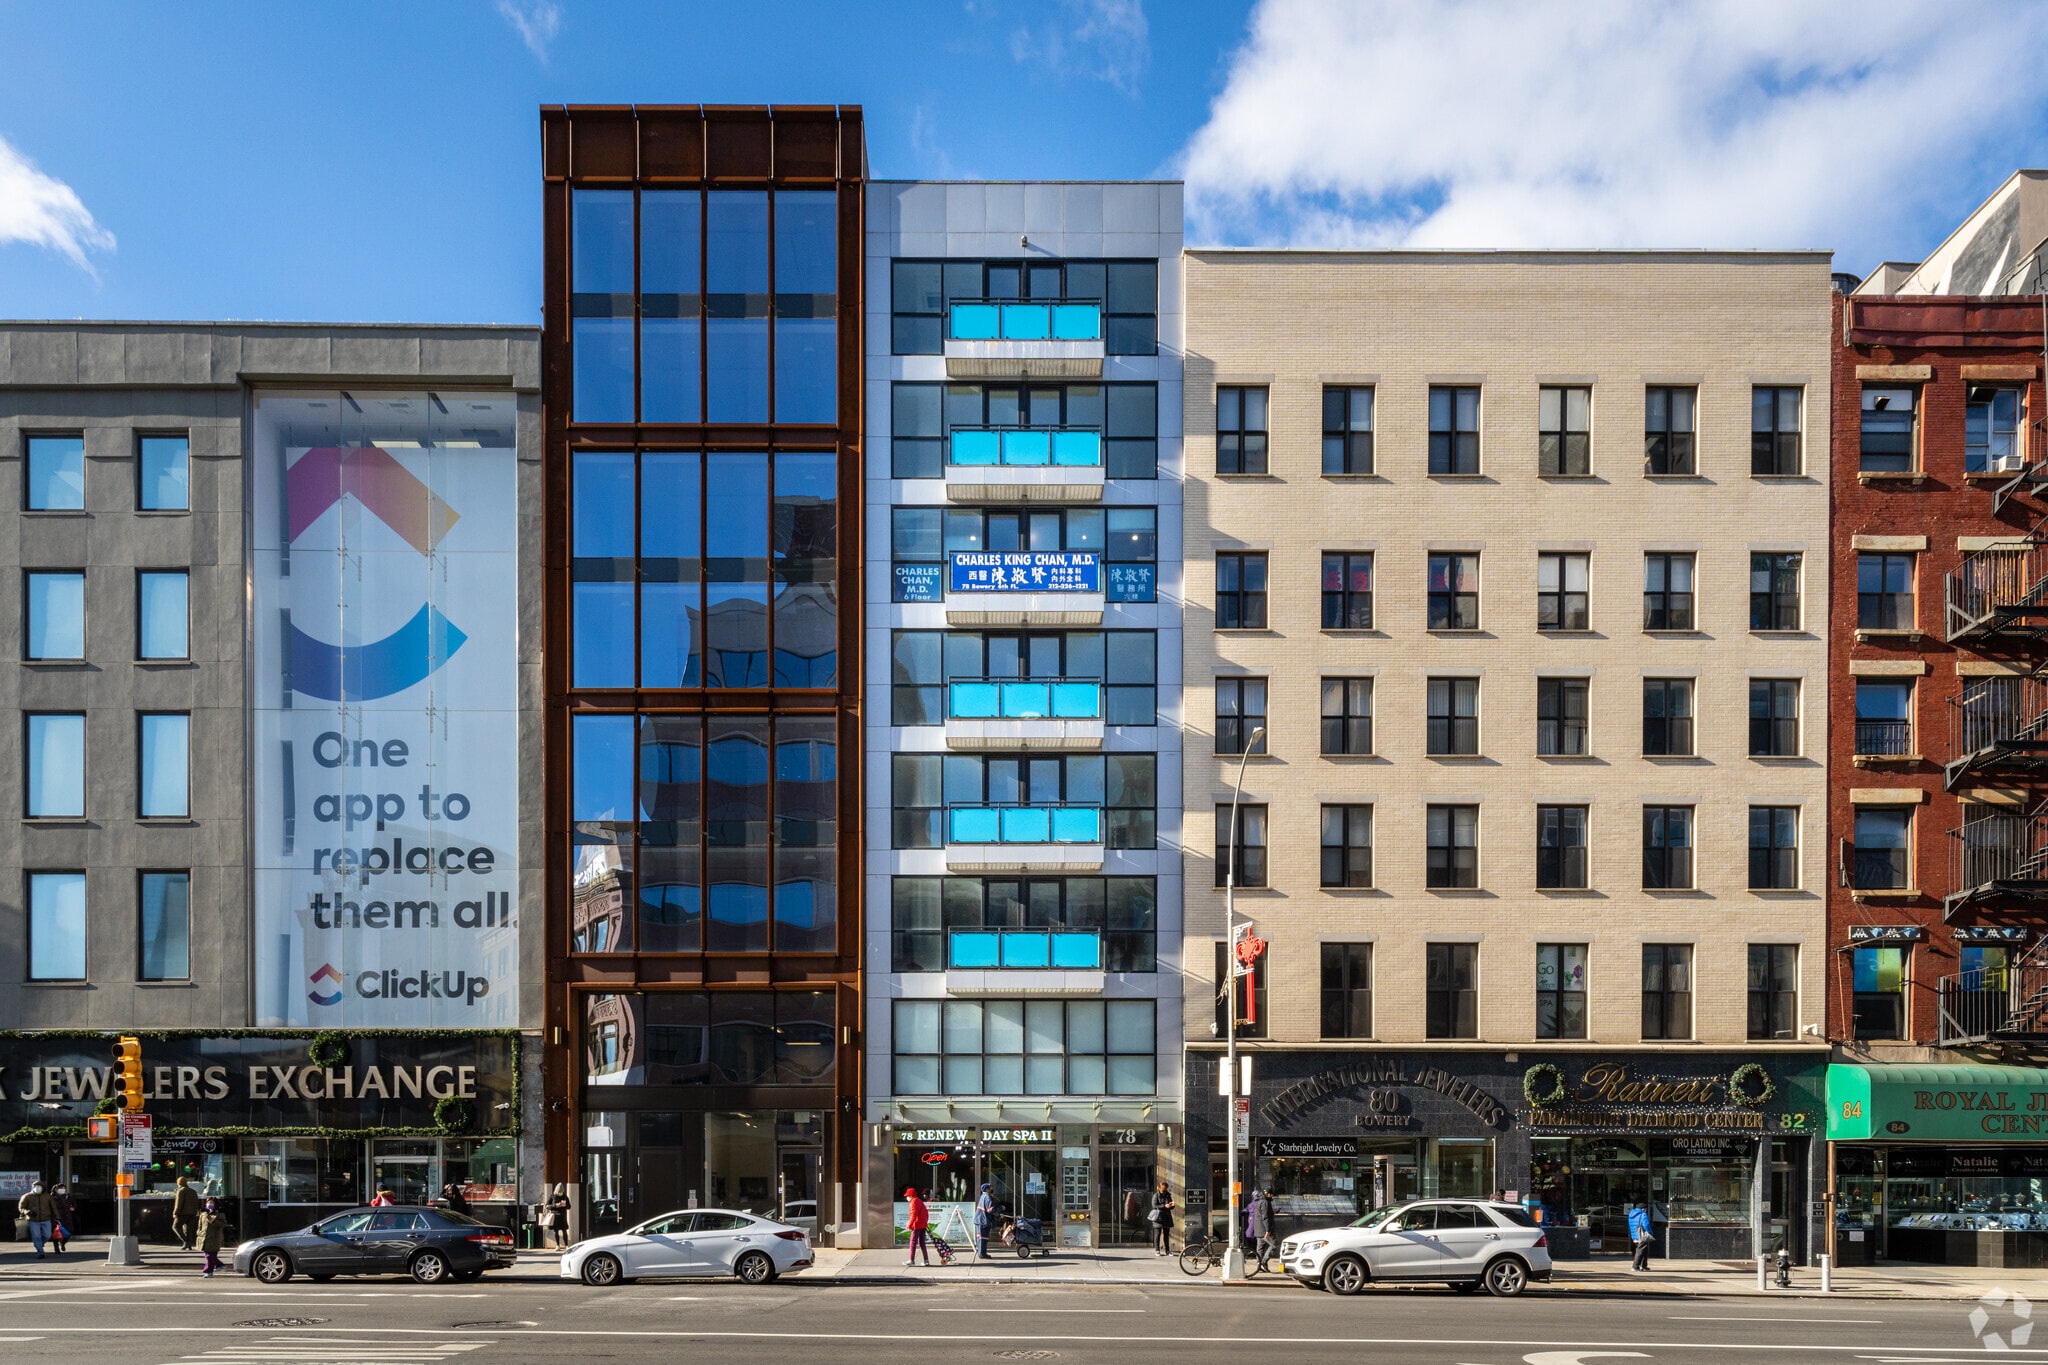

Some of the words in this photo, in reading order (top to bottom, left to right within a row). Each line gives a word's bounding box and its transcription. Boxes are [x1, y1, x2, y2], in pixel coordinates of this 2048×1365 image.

[956, 554, 1001, 566] CHARLES
[1004, 554, 1031, 566] KING
[1035, 554, 1068, 568] CHAN,
[1072, 554, 1095, 566] M.D.
[895, 567, 939, 576] CHARLES
[901, 576, 933, 586] CHAN,
[971, 583, 996, 591] Bowery
[906, 585, 929, 593] M.D.
[312, 731, 410, 769] One
[313, 792, 406, 832] app
[418, 784, 471, 822] to
[313, 838, 495, 886] replace
[310, 891, 439, 930] them
[356, 968, 490, 1007] ClickUp
[1539, 999, 1553, 1007] SPA
[20, 1066, 230, 1100] JEWERS
[249, 1065, 477, 1100] EXCHANGE
[1260, 1059, 1409, 1127] INTERNATIONAL
[1414, 1065, 1505, 1127] JEWELERS
[1369, 1089, 1399, 1113] 80
[1914, 1091, 2016, 1111] ROYAL
[1842, 1100, 1862, 1119] 84
[1355, 1114, 1411, 1127] BOWERY
[1529, 1112, 1623, 1127] PARAMOUNT
[1627, 1112, 1699, 1127] DIAMOND
[1704, 1112, 1763, 1128] CENTER
[1780, 1113, 1806, 1128] 82
[1890, 1123, 1905, 1132] 84
[901, 1132, 913, 1141] 78
[916, 1130, 968, 1141] RENEW
[982, 1130, 1008, 1141] DAY
[1012, 1130, 1038, 1141] SPA
[1041, 1130, 1052, 1141] II
[1115, 1129, 1137, 1144] 78
[161, 1139, 198, 1150] Jewelry
[1279, 1143, 1314, 1154] Starbright
[1316, 1143, 1342, 1154] Jewelry
[1343, 1143, 1356, 1152] Co.
[1672, 1138, 1690, 1148] ORO
[1690, 1138, 1717, 1148] LATINO
[1717, 1138, 1732, 1148] INC.
[921, 1152, 949, 1164] Open
[1952, 1156, 1999, 1167] Natalie
